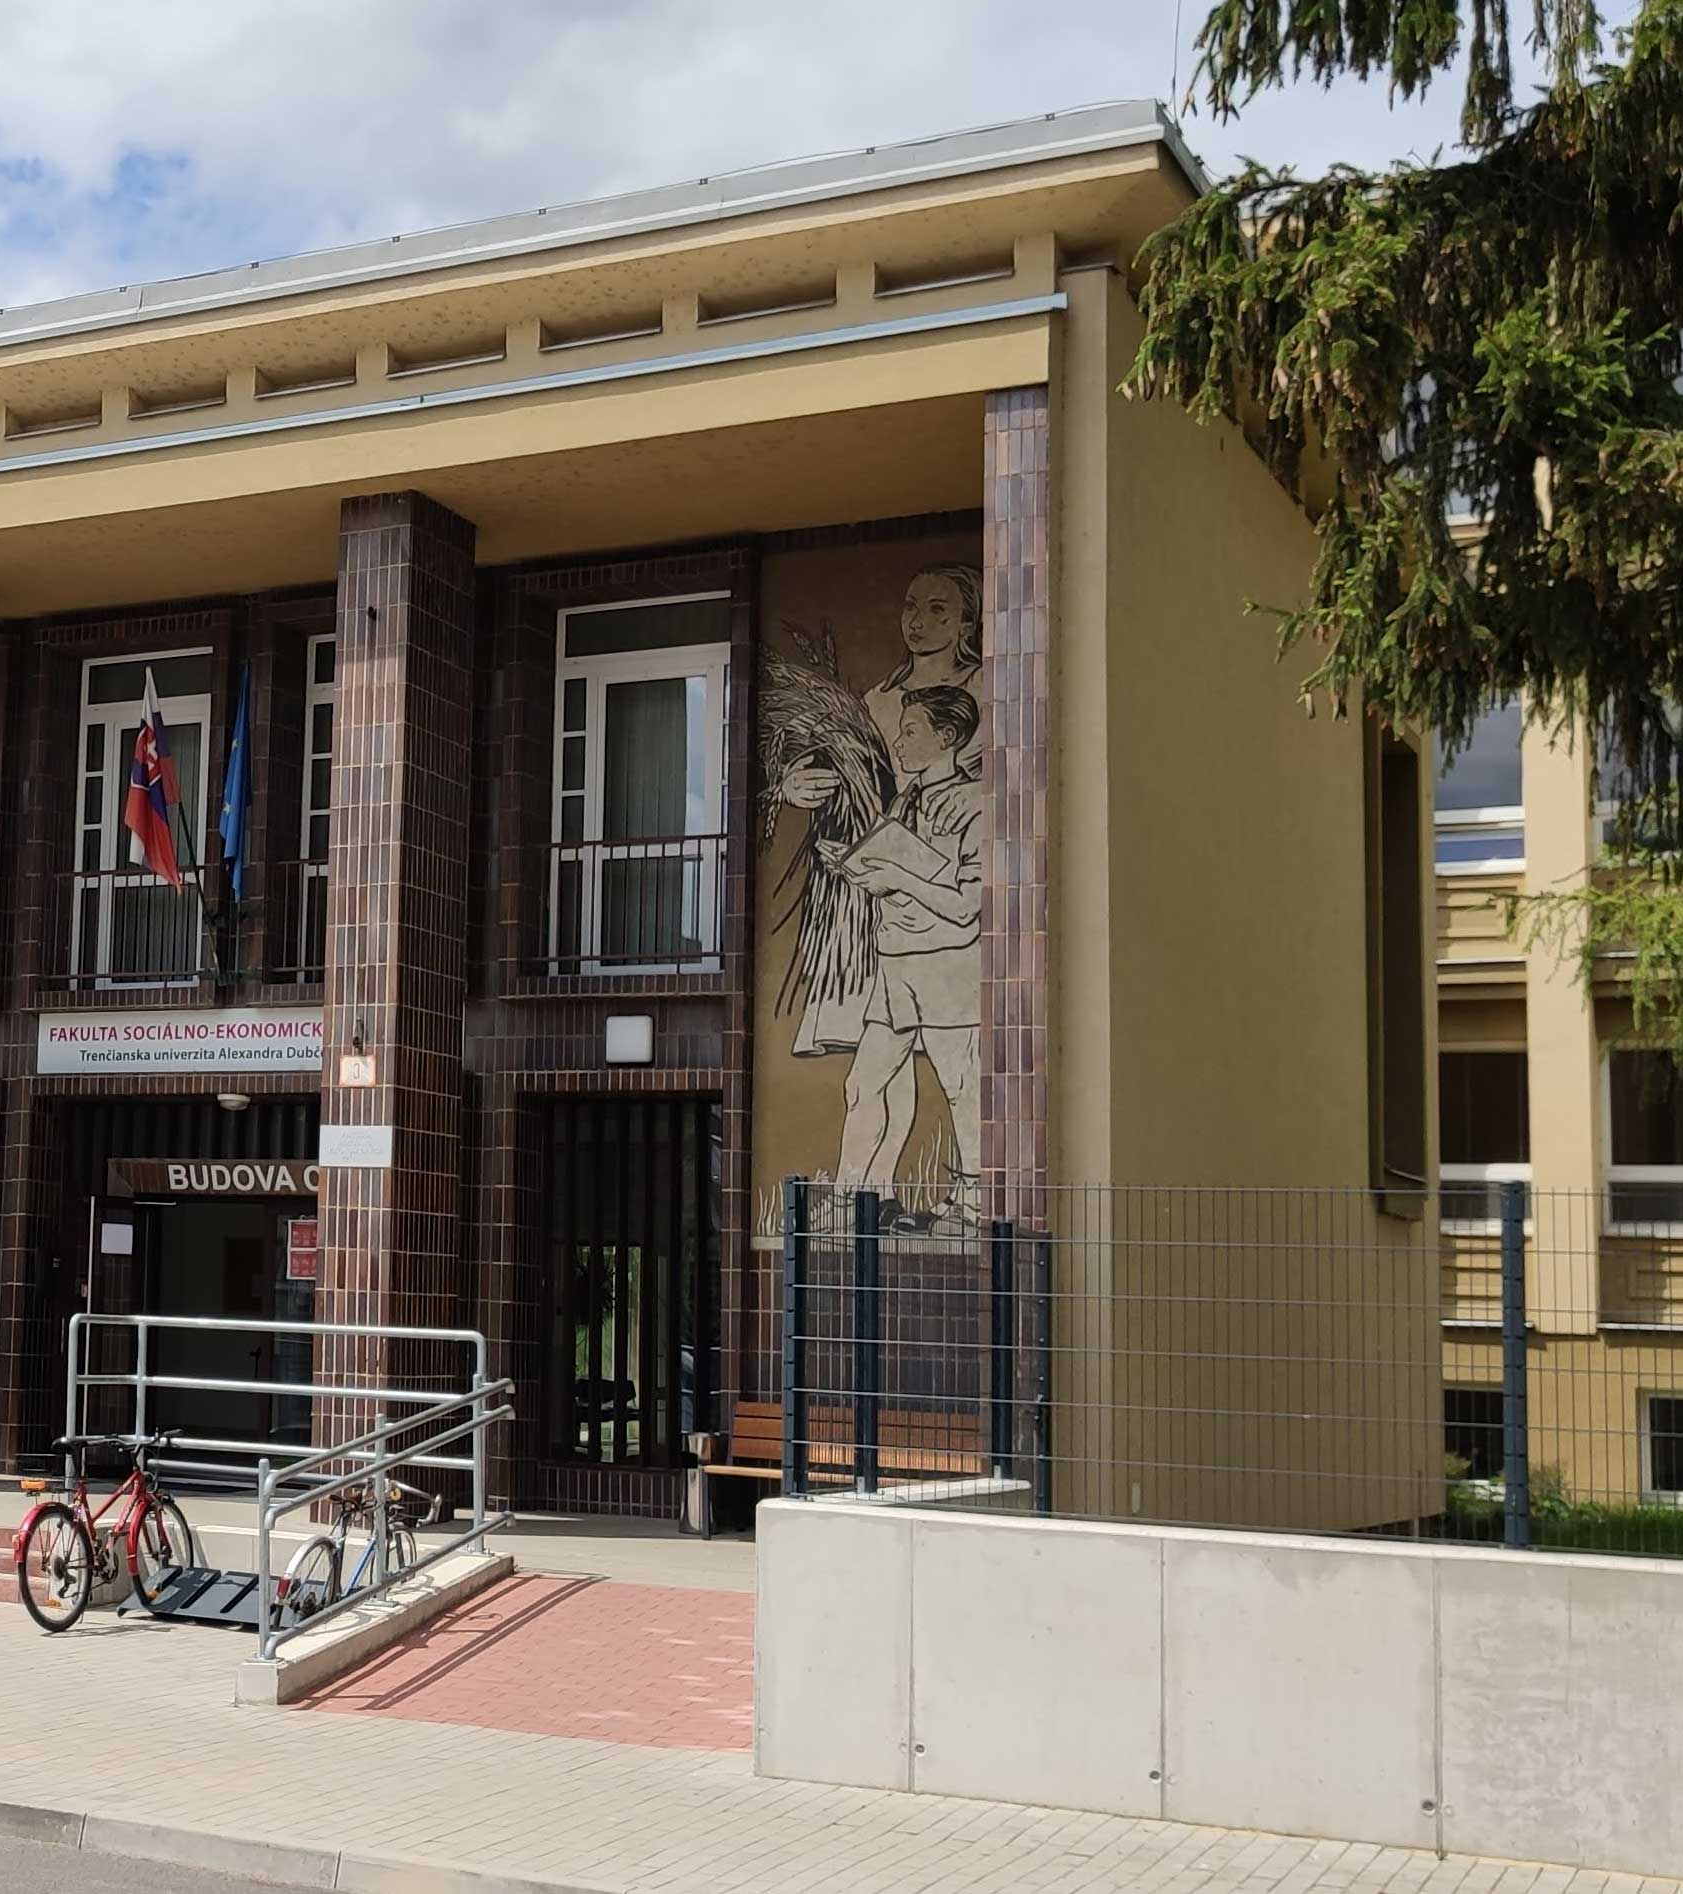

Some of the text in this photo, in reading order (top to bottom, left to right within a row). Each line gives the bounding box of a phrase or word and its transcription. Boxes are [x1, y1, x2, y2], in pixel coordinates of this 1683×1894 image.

[49, 1026, 118, 1042] FAKULTA
[80, 1049, 151, 1062] Trenčianska
[154, 1048, 215, 1061] univerzita
[218, 1046, 283, 1060] Alexandra
[167, 1164, 297, 1192] BUDOVA
